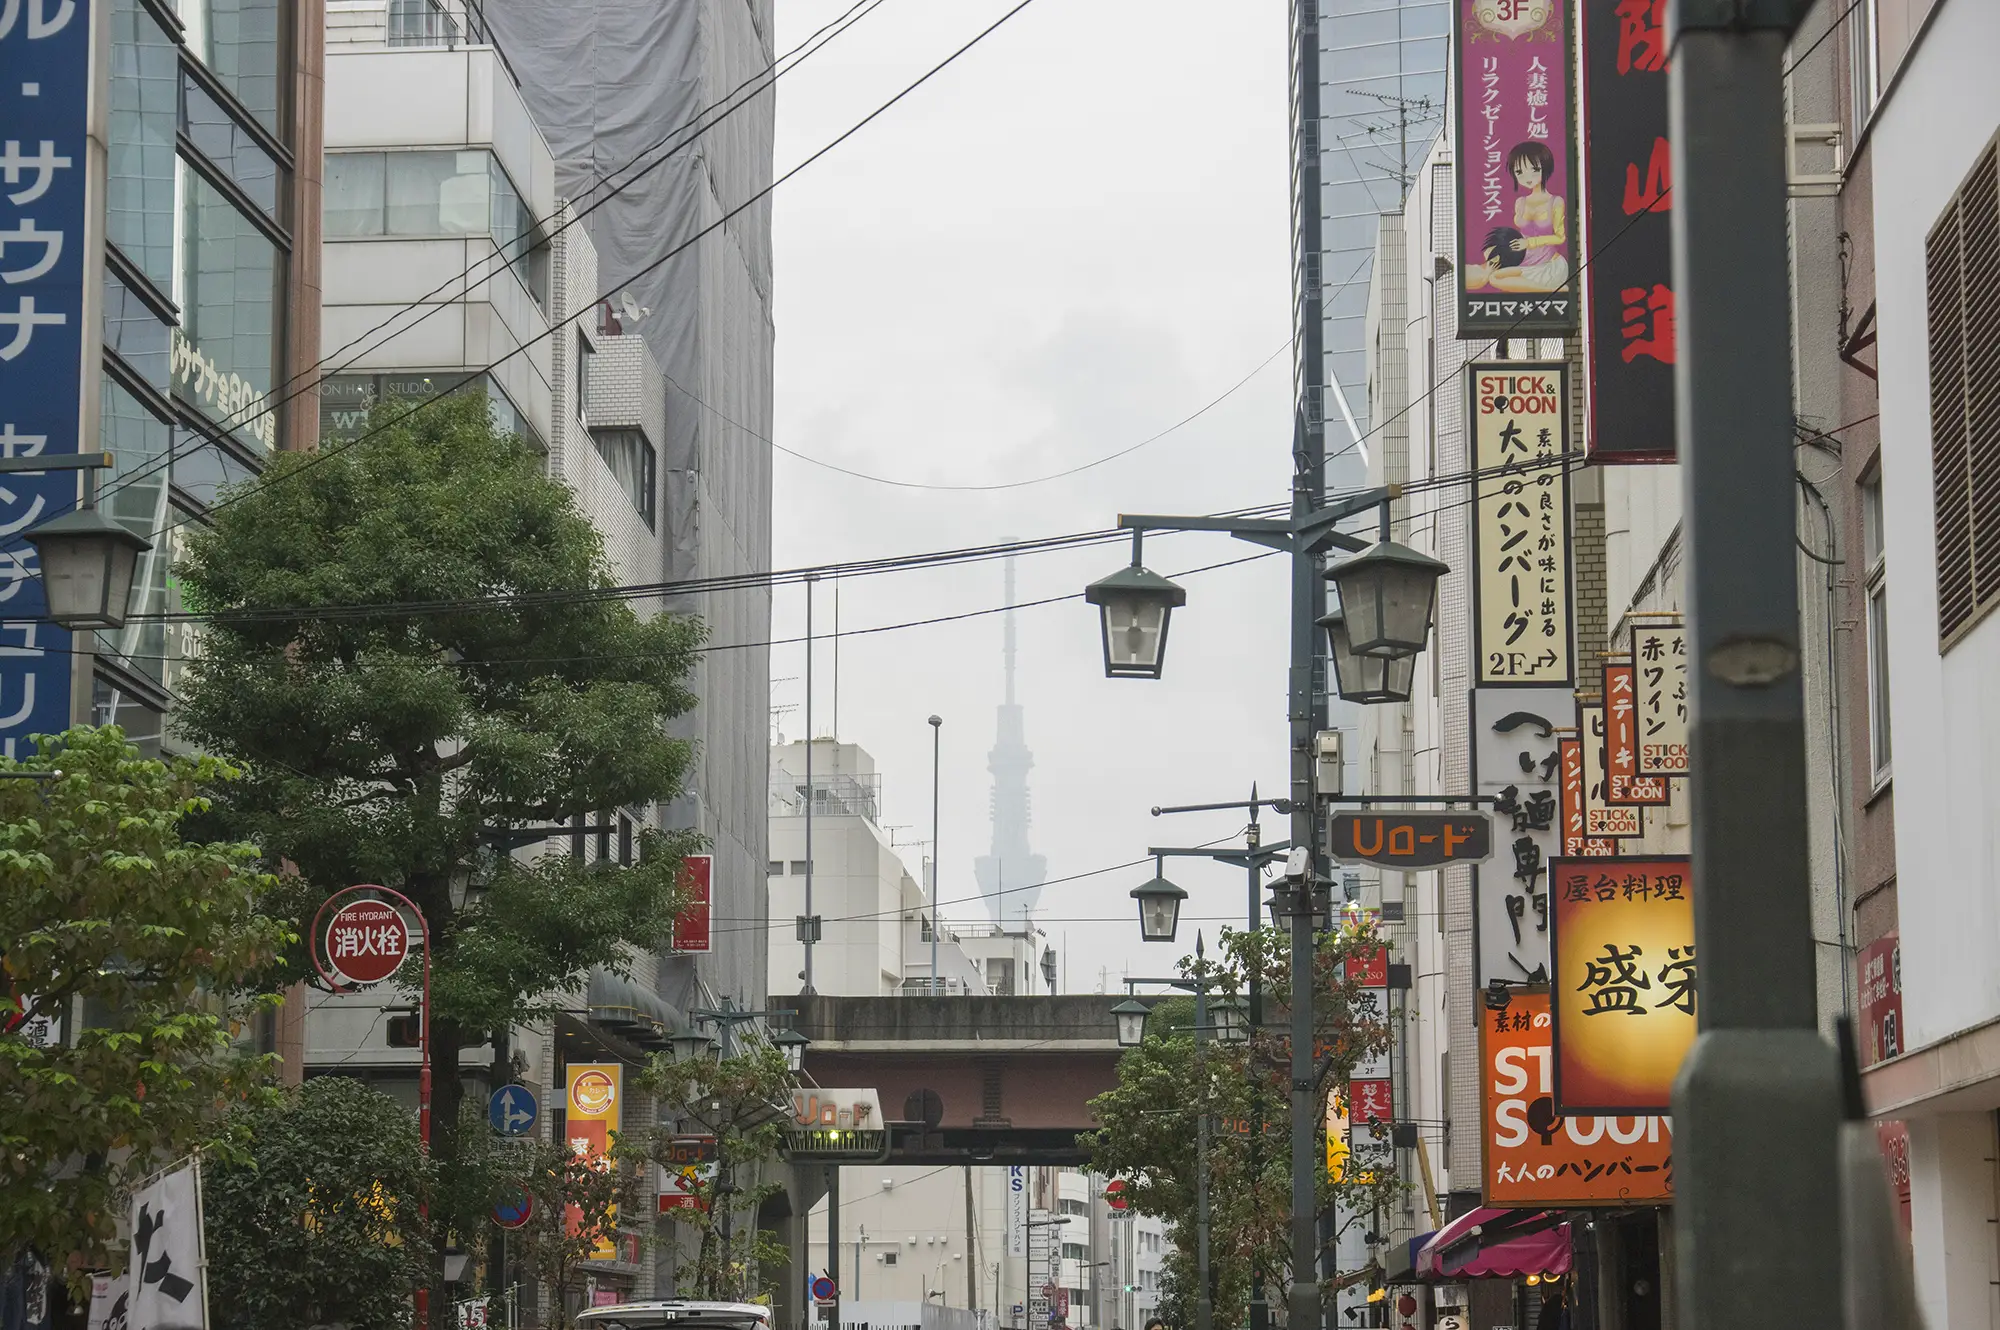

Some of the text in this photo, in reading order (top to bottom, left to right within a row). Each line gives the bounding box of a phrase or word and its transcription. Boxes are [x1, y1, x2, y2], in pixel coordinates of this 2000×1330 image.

[1496, 0, 1529, 20] 3F
[1527, 56, 1548, 139] 人妻癒し処
[1481, 57, 1502, 221] リラクゼーションエステ
[346, 383, 375, 395] HAIR
[388, 381, 434, 394] STUDIO
[1497, 419, 1534, 646] 大人のハンバーグ
[1536, 428, 1556, 637] 素材の良さが味に出る
[1490, 652, 1527, 676] 2F
[1641, 636, 1666, 736] 赤ワイン
[1612, 674, 1633, 769] ステーキ
[1563, 874, 1685, 903] 屋台料理
[341, 911, 394, 922] FIRE HYDRANT
[335, 924, 401, 958] 消火栓
[1365, 1067, 1376, 1075] 2F
